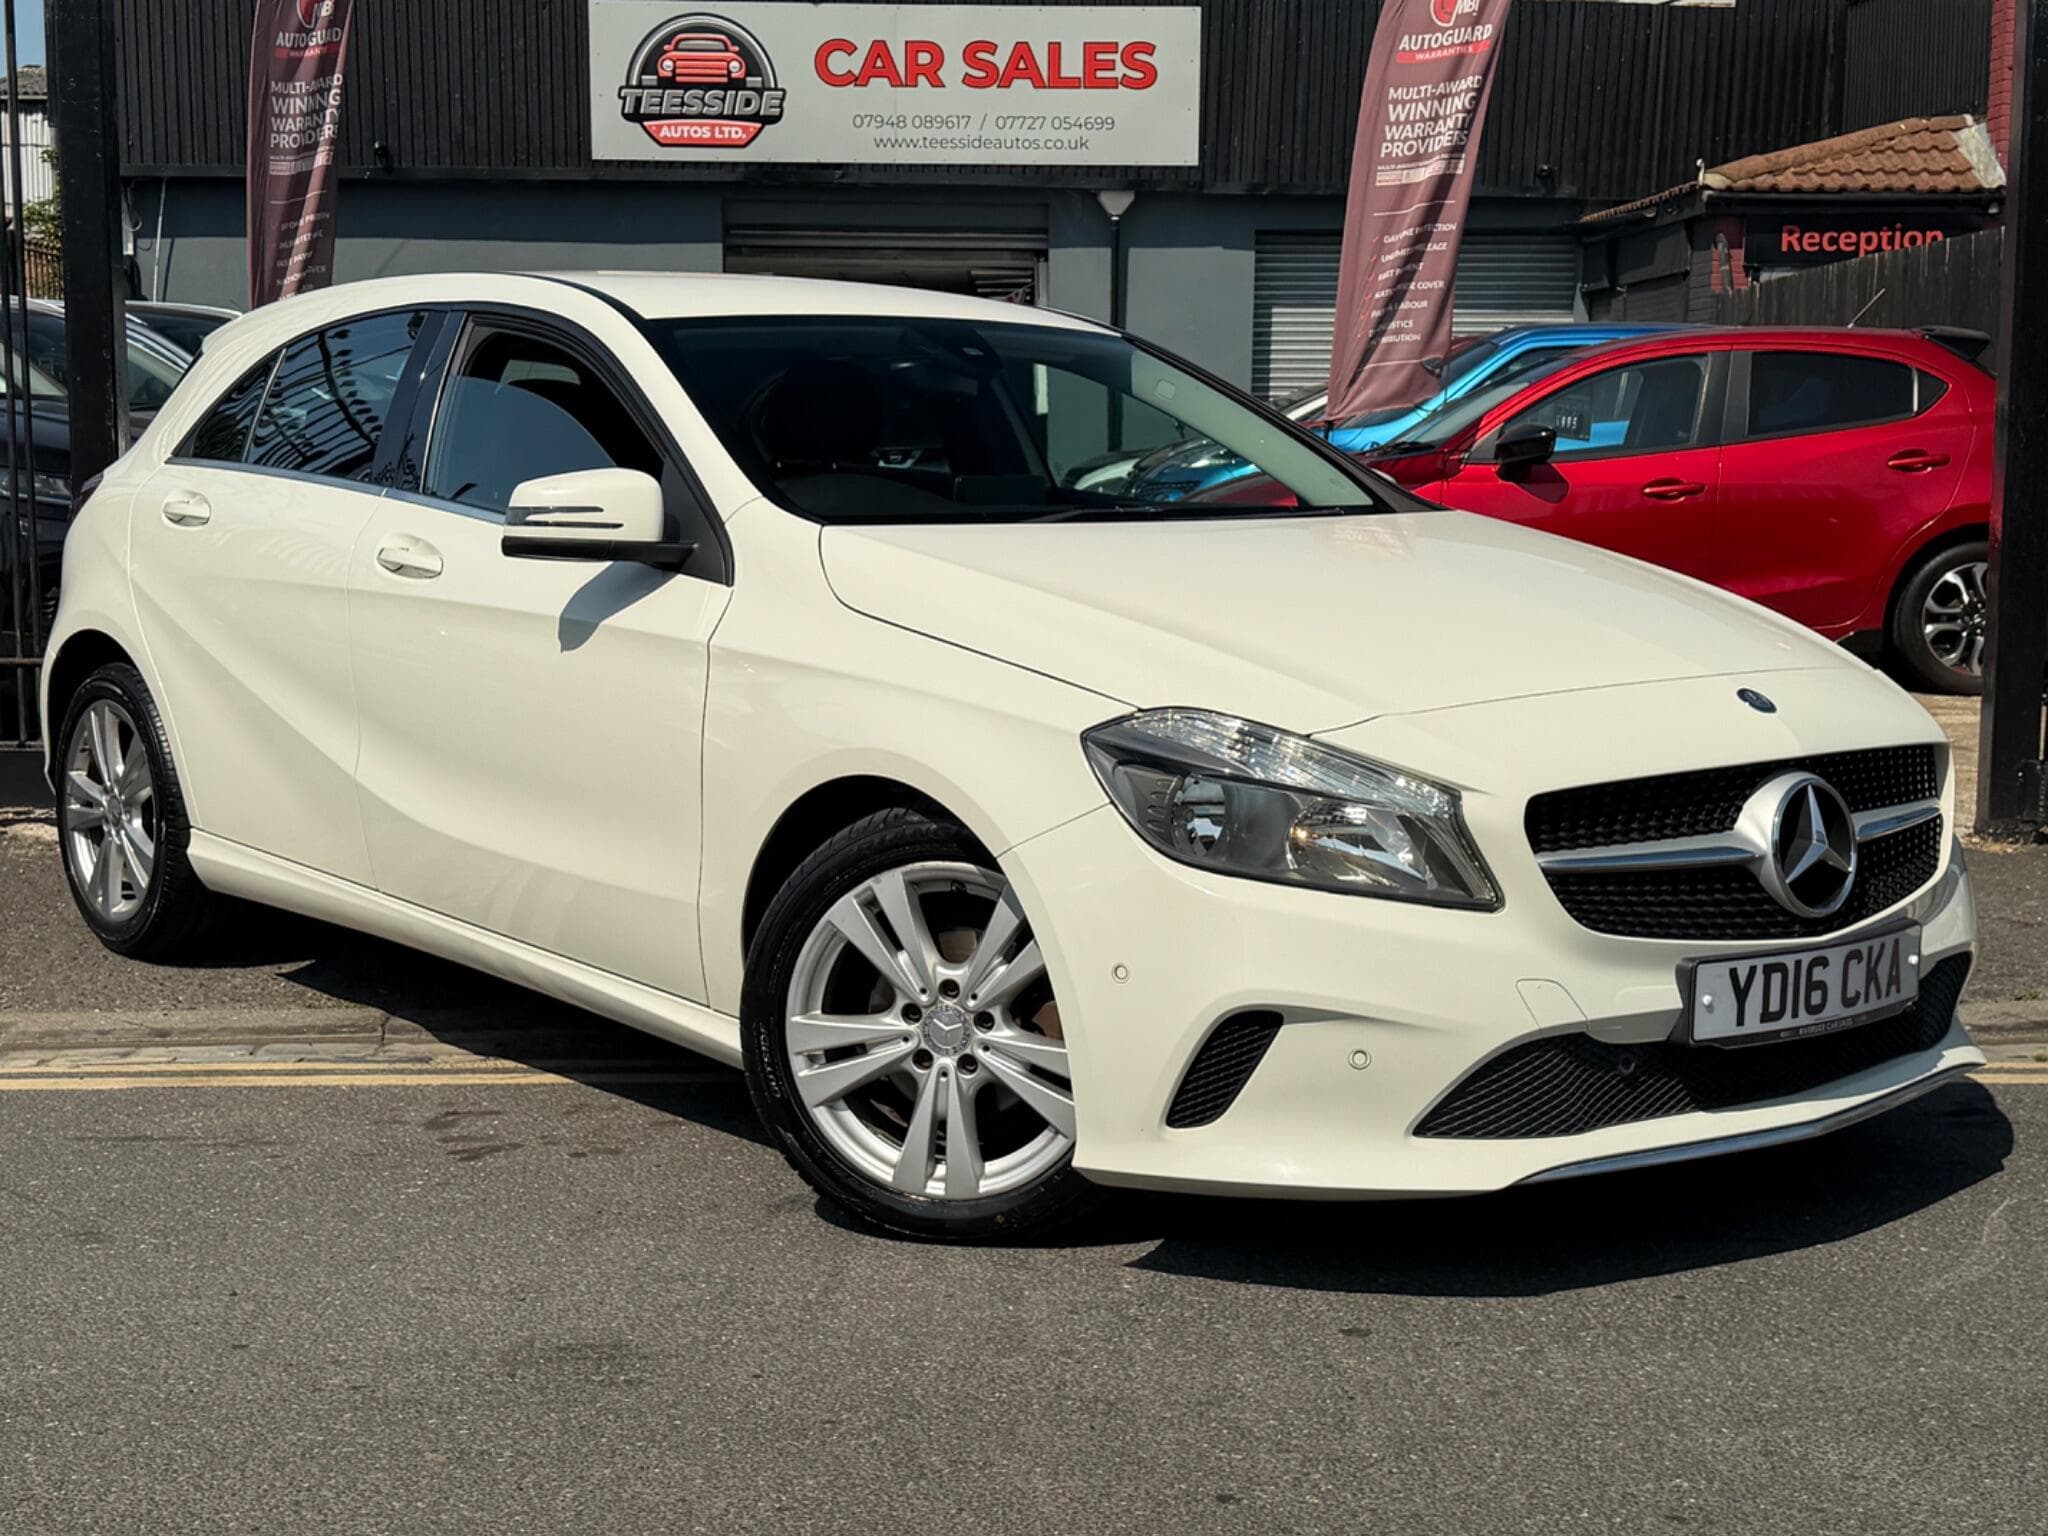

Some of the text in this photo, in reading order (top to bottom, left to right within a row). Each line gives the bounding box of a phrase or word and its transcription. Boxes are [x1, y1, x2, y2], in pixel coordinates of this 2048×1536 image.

[1399, 24, 1493, 51] AUTOGUARD
[814, 38, 1158, 90] CAR SALES
[1388, 75, 1482, 100] MULTI-AWARD
[620, 88, 785, 116] TEESSIDE
[1388, 92, 1477, 122] WINNING
[659, 125, 746, 139] AUTOS LTD.
[852, 114, 907, 129] 07948
[911, 115, 972, 129] 089617
[995, 115, 1046, 130] 07727
[1051, 116, 1115, 131] 054699
[1384, 113, 1472, 140] WARRANTY
[874, 134, 1090, 150] www.teessideautos.co.uk
[1781, 223, 1945, 257] Reception
[1729, 938, 1901, 1027] YD16 CKA
